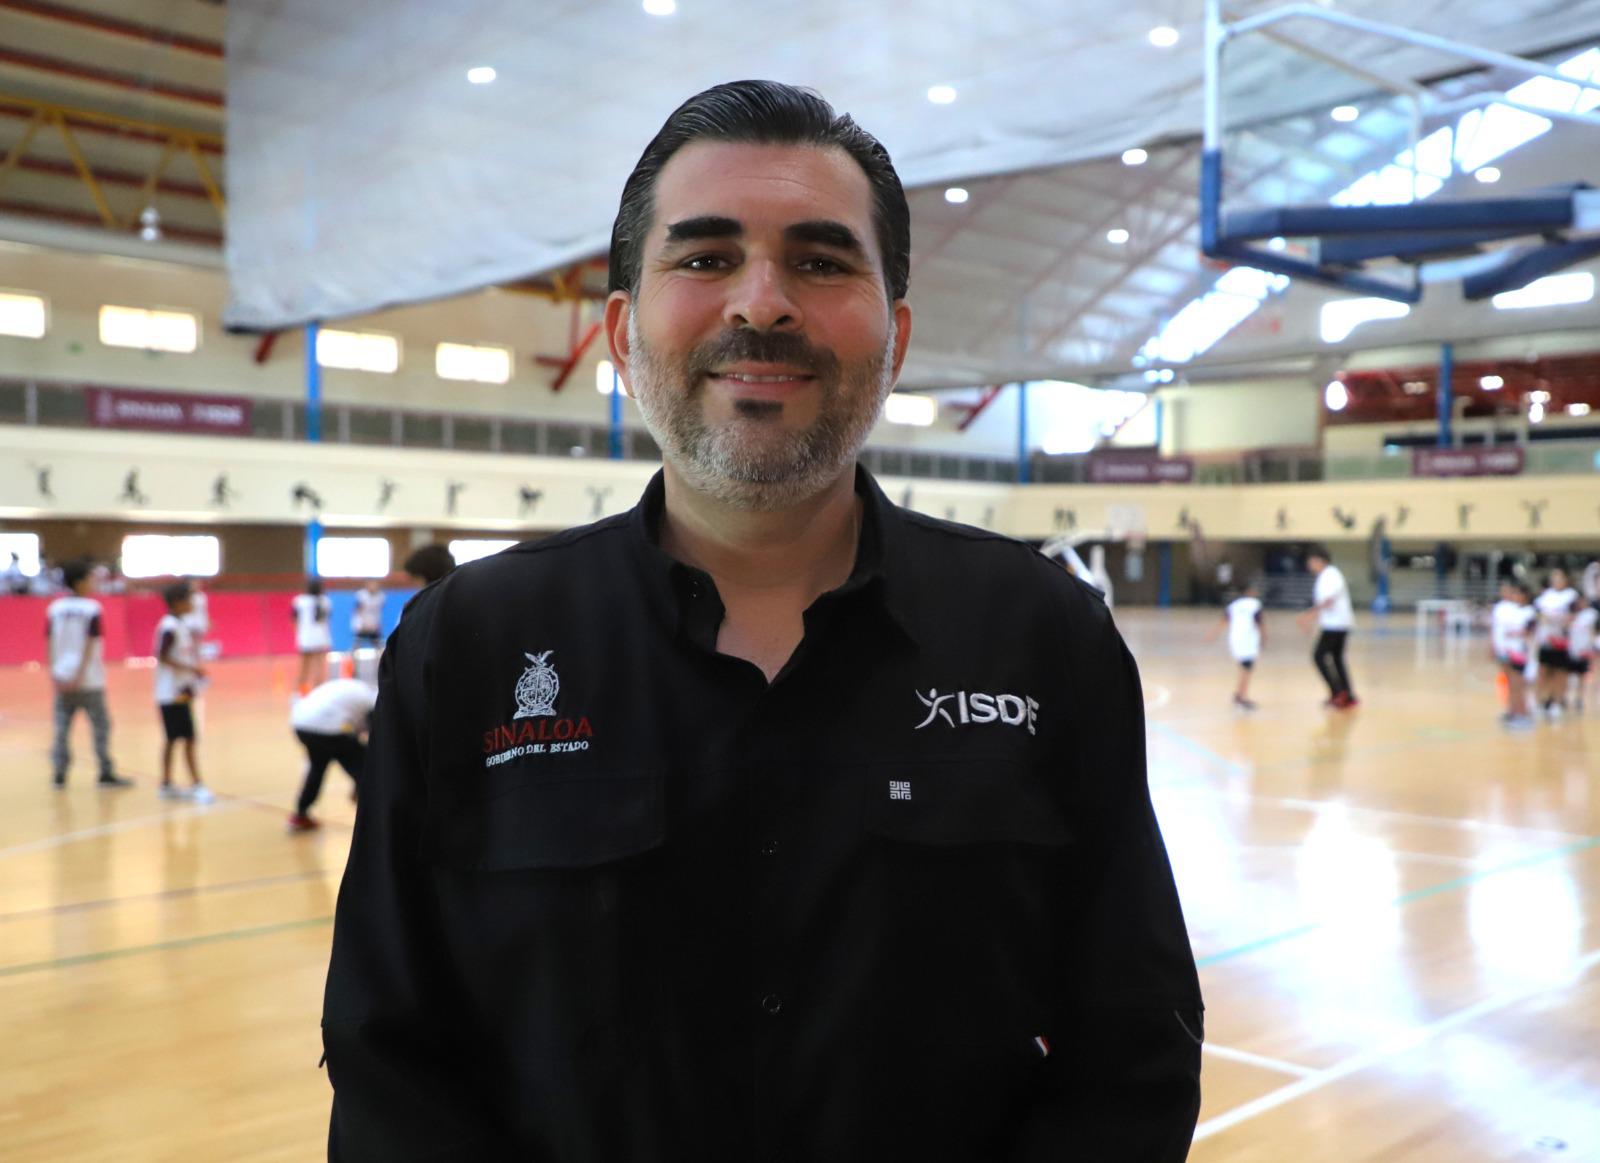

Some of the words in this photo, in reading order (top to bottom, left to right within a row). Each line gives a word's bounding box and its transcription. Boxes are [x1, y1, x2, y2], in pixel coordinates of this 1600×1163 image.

[483, 716, 593, 753] SINALOA
[486, 746, 525, 768] GOBIERNO
[526, 743, 547, 754] DEL
[549, 740, 589, 753] ESTADO
